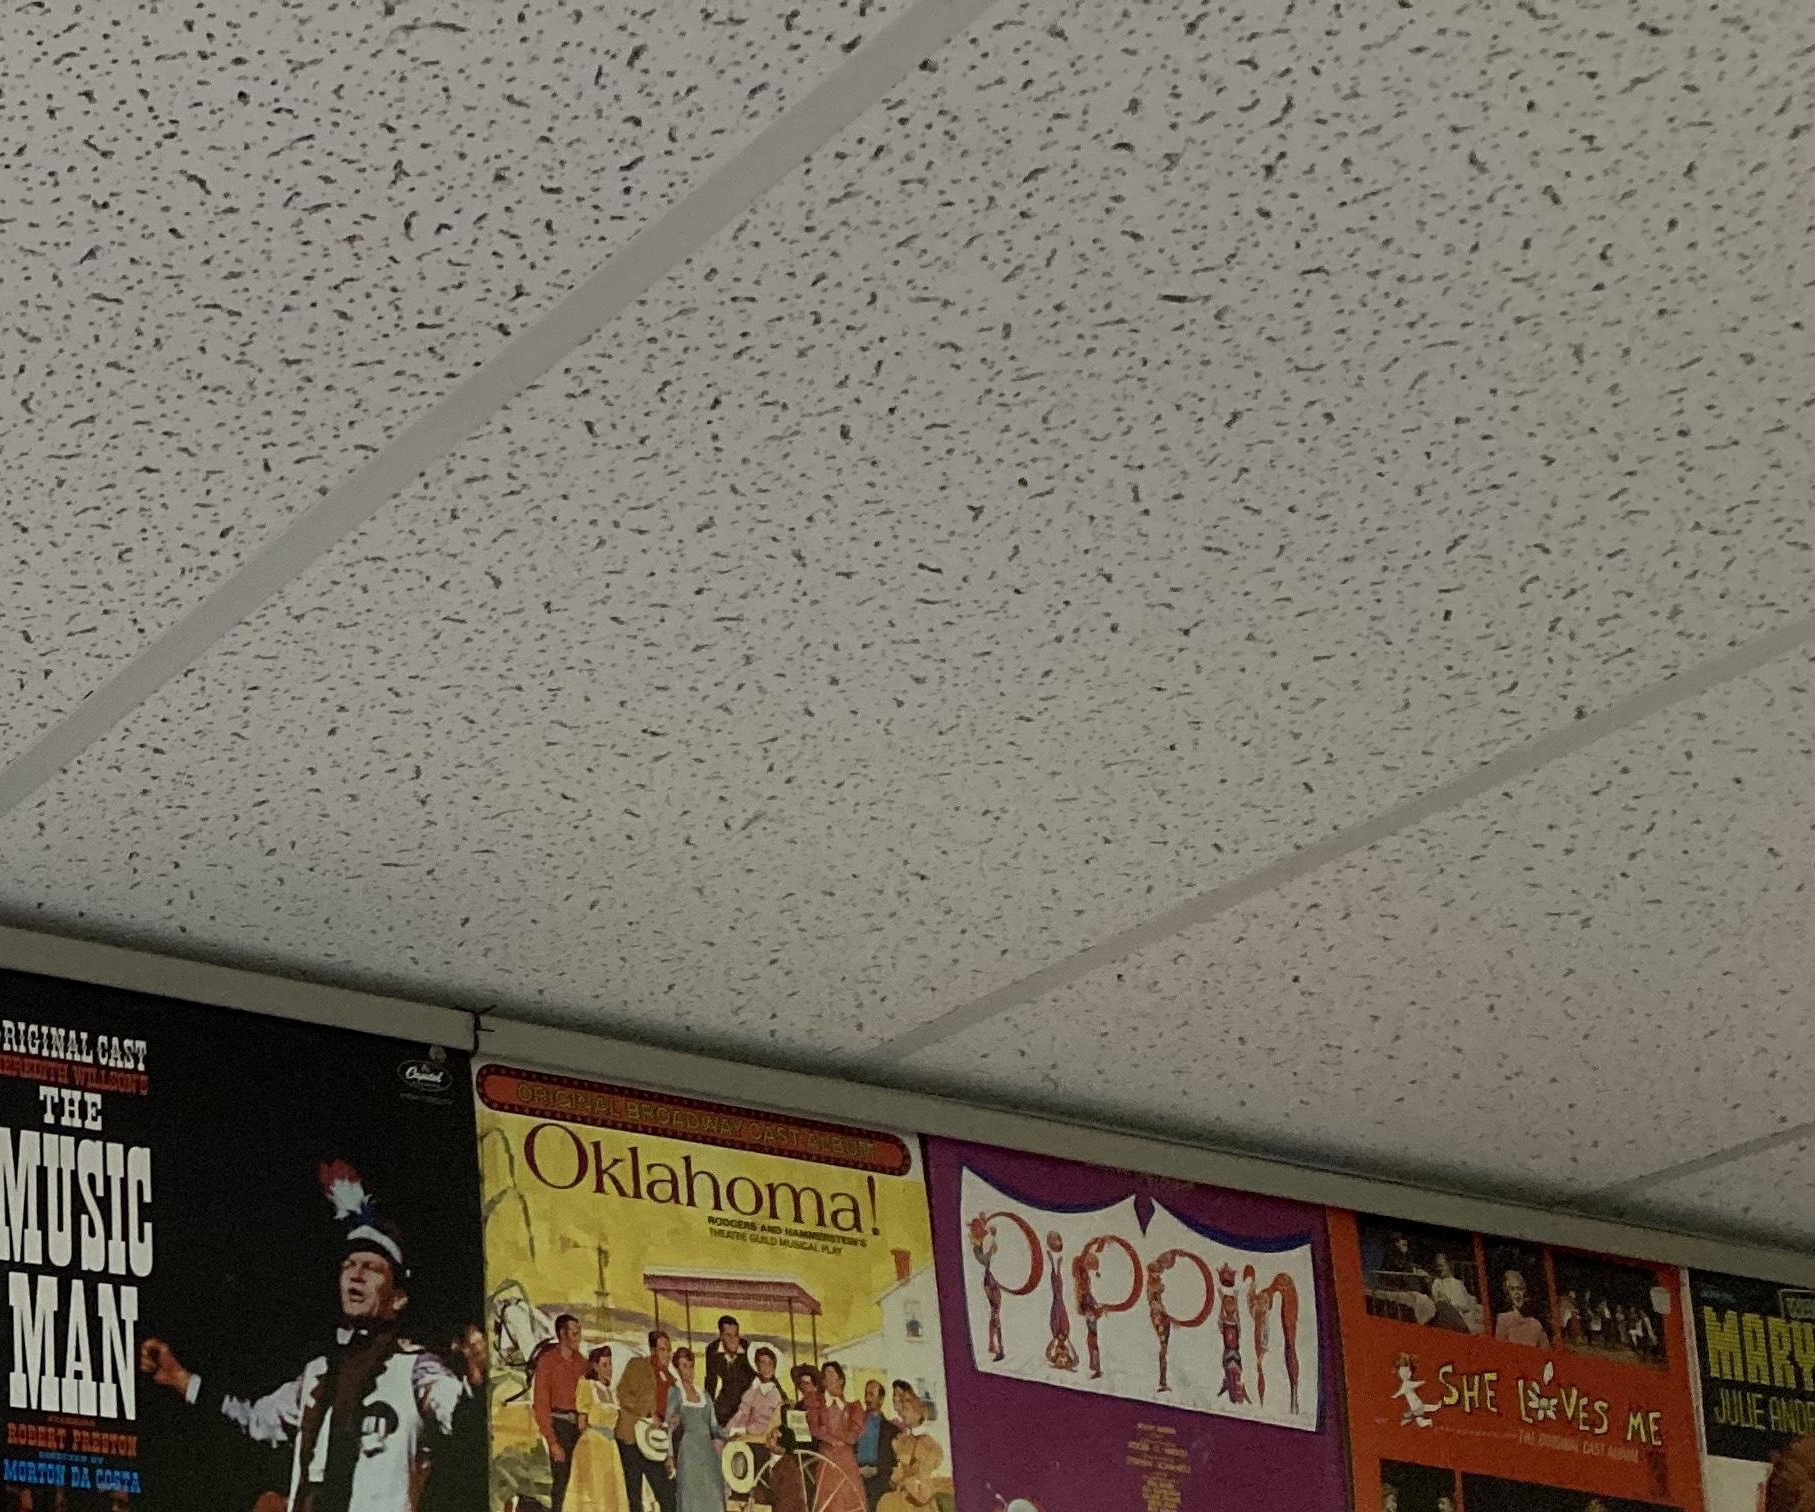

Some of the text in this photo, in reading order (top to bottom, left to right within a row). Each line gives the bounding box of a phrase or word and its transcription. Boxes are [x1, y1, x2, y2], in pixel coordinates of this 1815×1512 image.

[97, 1035, 147, 1071] CAST
[39, 1085, 102, 1131] THE
[515, 1081, 620, 1118] ORIGINAL
[626, 1101, 743, 1136] BROADWAY
[749, 1122, 801, 1145] CAST
[524, 1122, 881, 1237] Oklahoma!
[708, 1215, 757, 1232] RODGERS
[760, 1222, 783, 1235] AND
[8, 1272, 138, 1421] MAN
[1703, 1305, 1815, 1392] MARY
[1438, 1364, 1498, 1413] SHE
[1626, 1411, 1663, 1446] ME
[1713, 1388, 1766, 1431] JULIE
[7, 1422, 138, 1457] ROBERT PRESTON
[3, 1458, 142, 1494] MORTON DA COSTA
